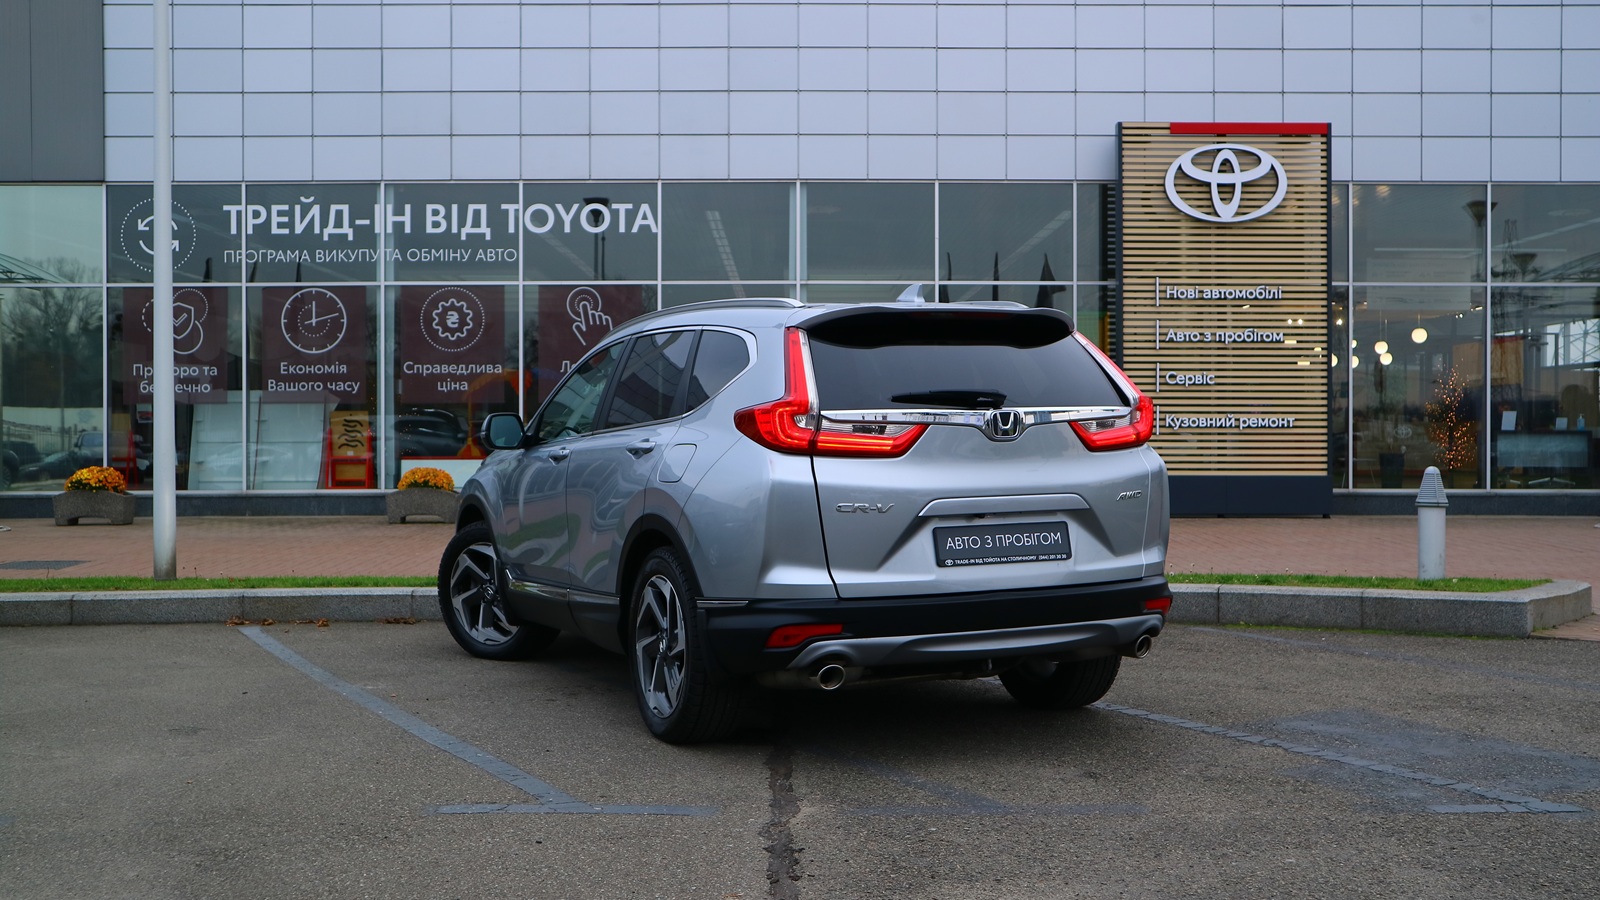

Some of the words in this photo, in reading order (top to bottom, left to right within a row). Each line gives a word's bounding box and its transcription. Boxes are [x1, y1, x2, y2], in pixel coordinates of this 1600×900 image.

[223, 196, 411, 241] ТРЕЙД-ІН
[425, 203, 491, 241] ВІД
[500, 203, 658, 233] TOYOTA
[224, 249, 311, 263] ПРОГРАМА
[315, 249, 380, 262] ВИКУПУ
[384, 248, 403, 262] ТА
[406, 248, 471, 262] ОБМІНУ
[475, 248, 518, 262] АВТО
[1165, 285, 1199, 299] Нові
[1203, 285, 1283, 299] автомобілі
[1165, 328, 1201, 342] Авто
[1203, 332, 1212, 342] з
[1216, 328, 1284, 345] пробігом
[133, 363, 199, 379] Проро
[202, 366, 218, 376] та
[279, 361, 348, 375] Економія
[403, 361, 503, 376] Справедлива
[140, 380, 211, 393] бечно
[268, 379, 324, 392] Вашого
[327, 380, 360, 394] часу
[437, 378, 469, 393] ціна
[1165, 371, 1216, 387] Сервіс
[1165, 413, 1236, 430] Кузовний
[1239, 417, 1295, 430] ремонт
[1116, 490, 1142, 501] AWD
[836, 502, 895, 514] CR-V
[946, 536, 981, 550] АВТО
[995, 532, 1062, 547] ПРОБІГОМ
